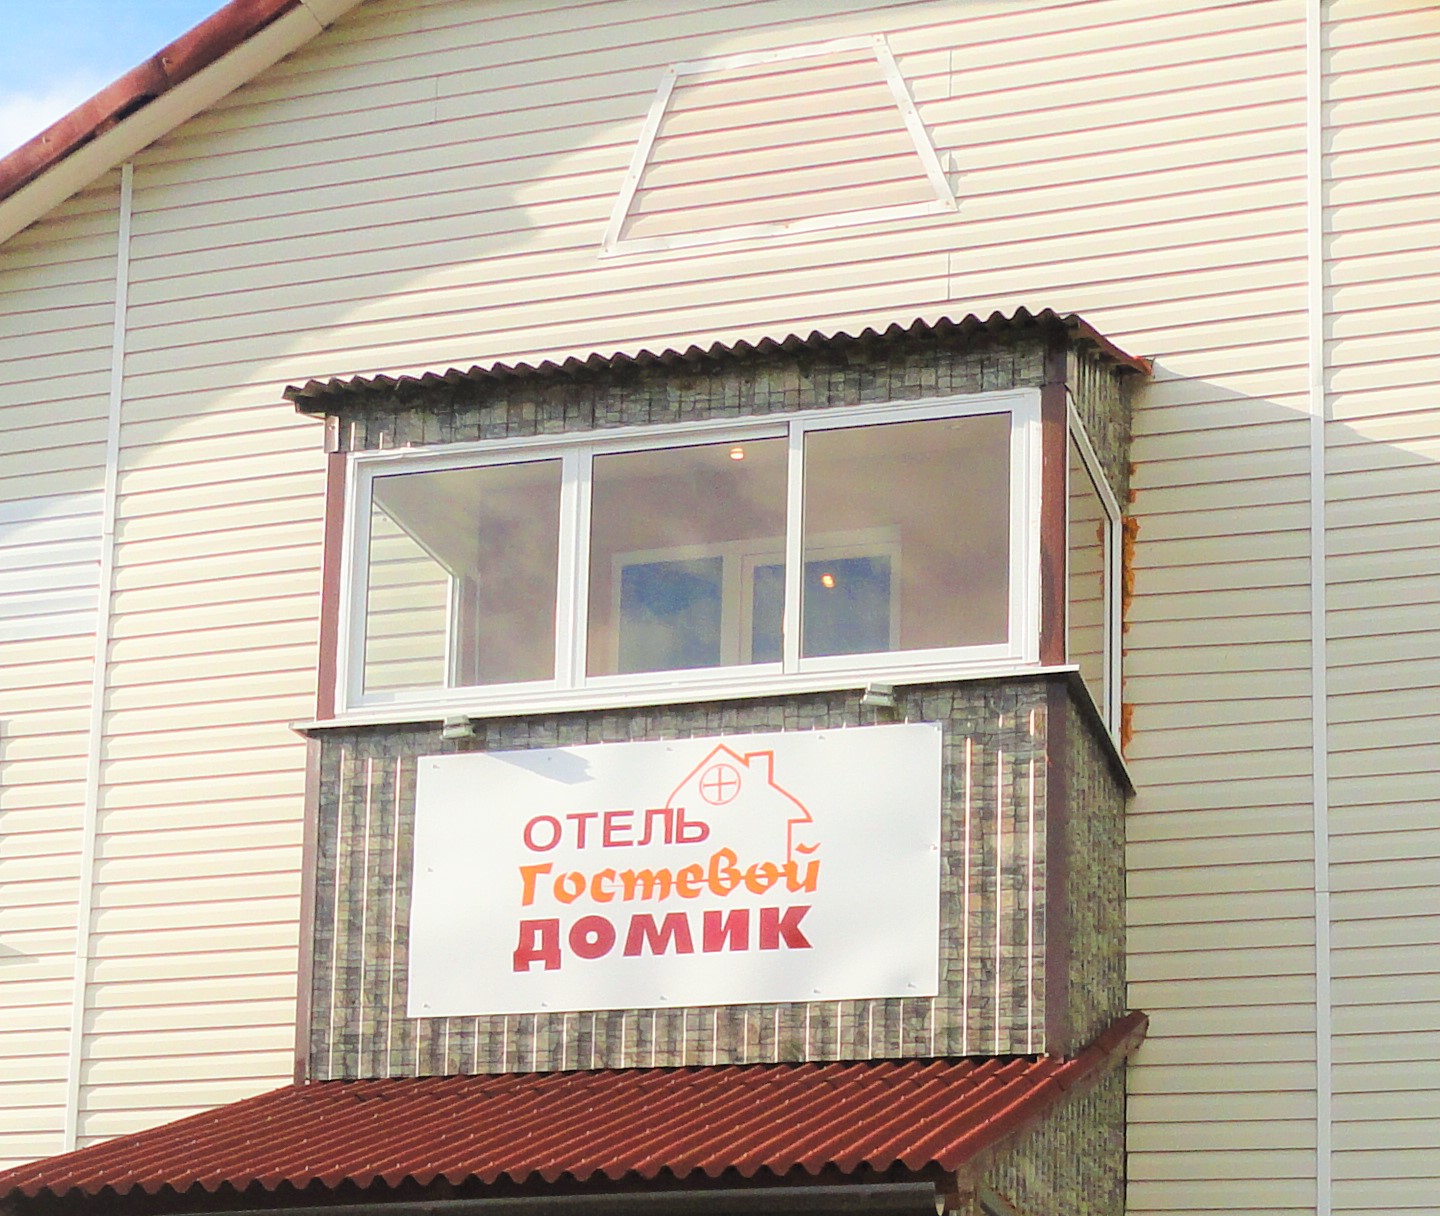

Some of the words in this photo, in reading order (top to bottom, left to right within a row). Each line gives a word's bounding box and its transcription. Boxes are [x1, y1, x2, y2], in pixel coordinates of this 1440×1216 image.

[523, 806, 710, 852] ОТЕЛЬ
[519, 842, 821, 906] Гостевой
[512, 905, 813, 972] ДОМИК
